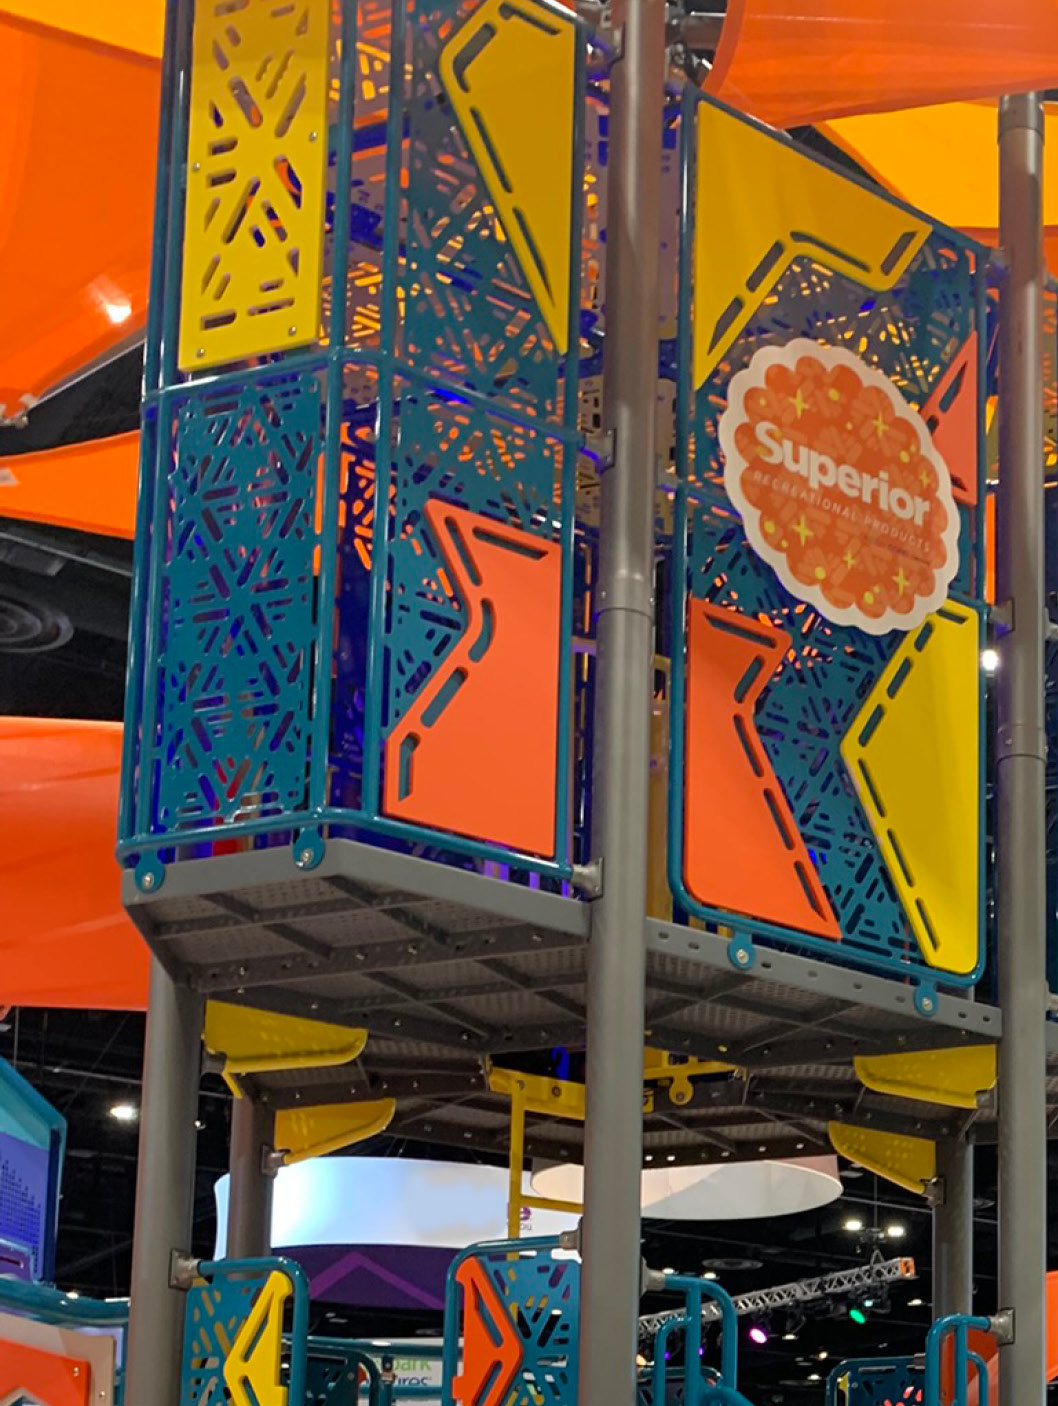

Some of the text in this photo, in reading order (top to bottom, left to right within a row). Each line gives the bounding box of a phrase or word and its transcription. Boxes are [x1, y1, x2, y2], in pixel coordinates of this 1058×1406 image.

[753, 469, 932, 553] RECREATIONAL PRODUCTS
[754, 420, 932, 527] Superior
